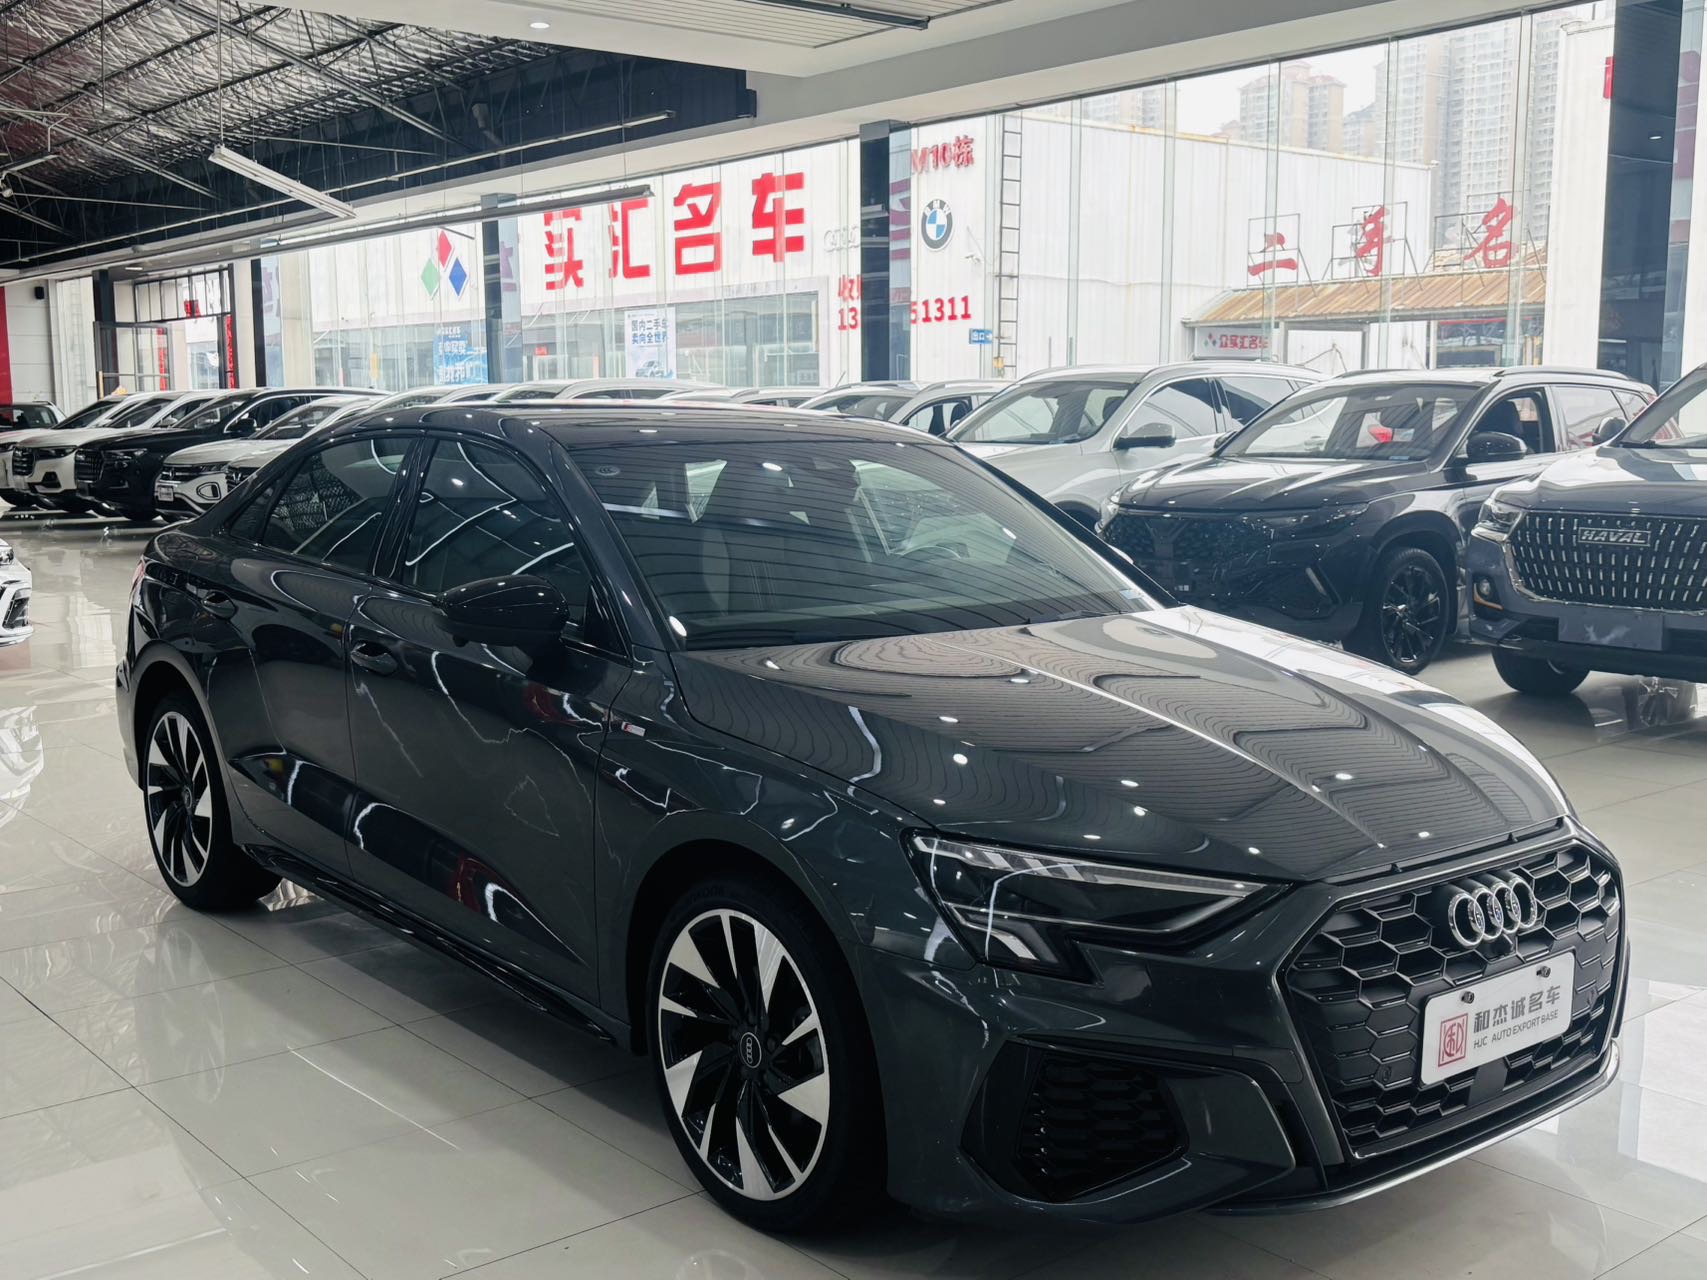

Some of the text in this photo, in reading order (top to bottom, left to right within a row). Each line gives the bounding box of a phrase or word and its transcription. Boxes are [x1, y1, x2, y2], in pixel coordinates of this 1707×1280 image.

[544, 172, 804, 290] 实汇名车
[1581, 530, 1646, 543] HAVAL
[1473, 985, 1561, 1033] 和杰诚名车
[1473, 1035, 1488, 1049] HJC
[1491, 1026, 1512, 1042] AUTO
[1512, 1016, 1541, 1036] EXPORT
[1541, 1009, 1559, 1025] BASE
